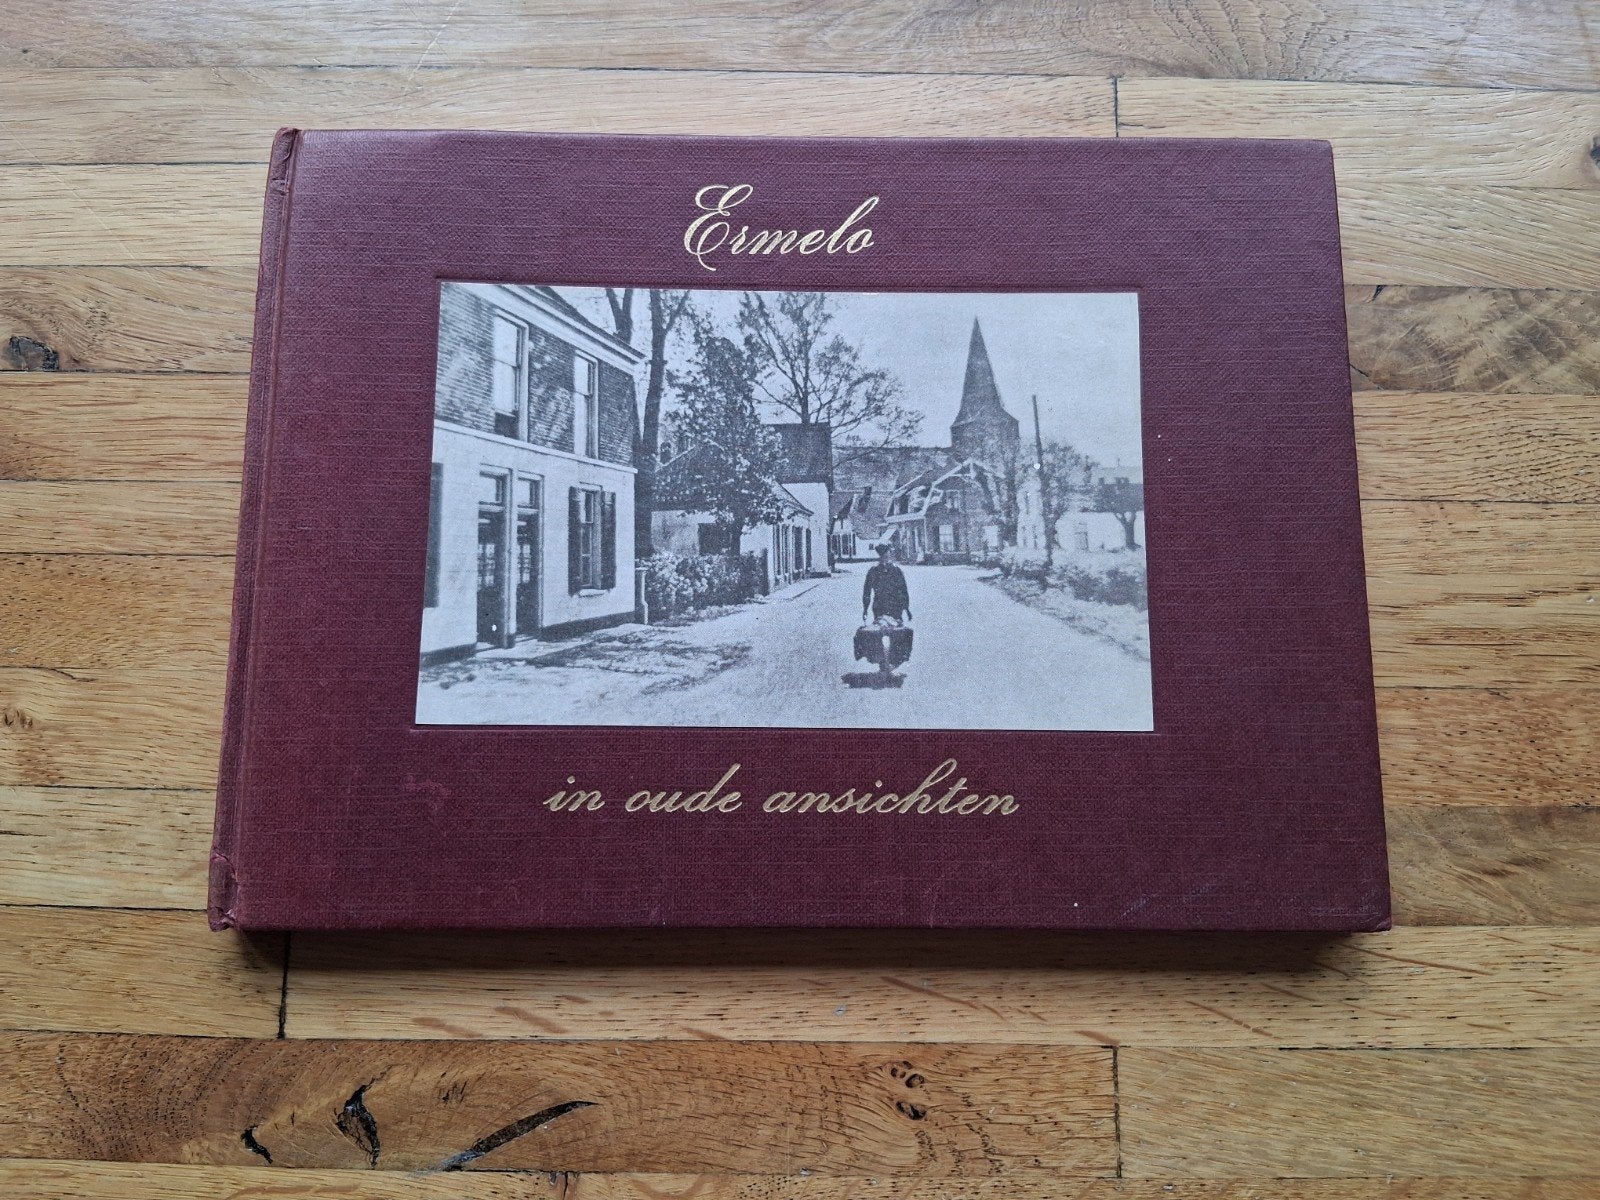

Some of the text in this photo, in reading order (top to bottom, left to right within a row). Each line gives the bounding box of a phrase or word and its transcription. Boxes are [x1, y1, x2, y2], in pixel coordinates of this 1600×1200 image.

[683, 183, 881, 272] Ermelo
[542, 758, 1020, 816] in oude ansichten
